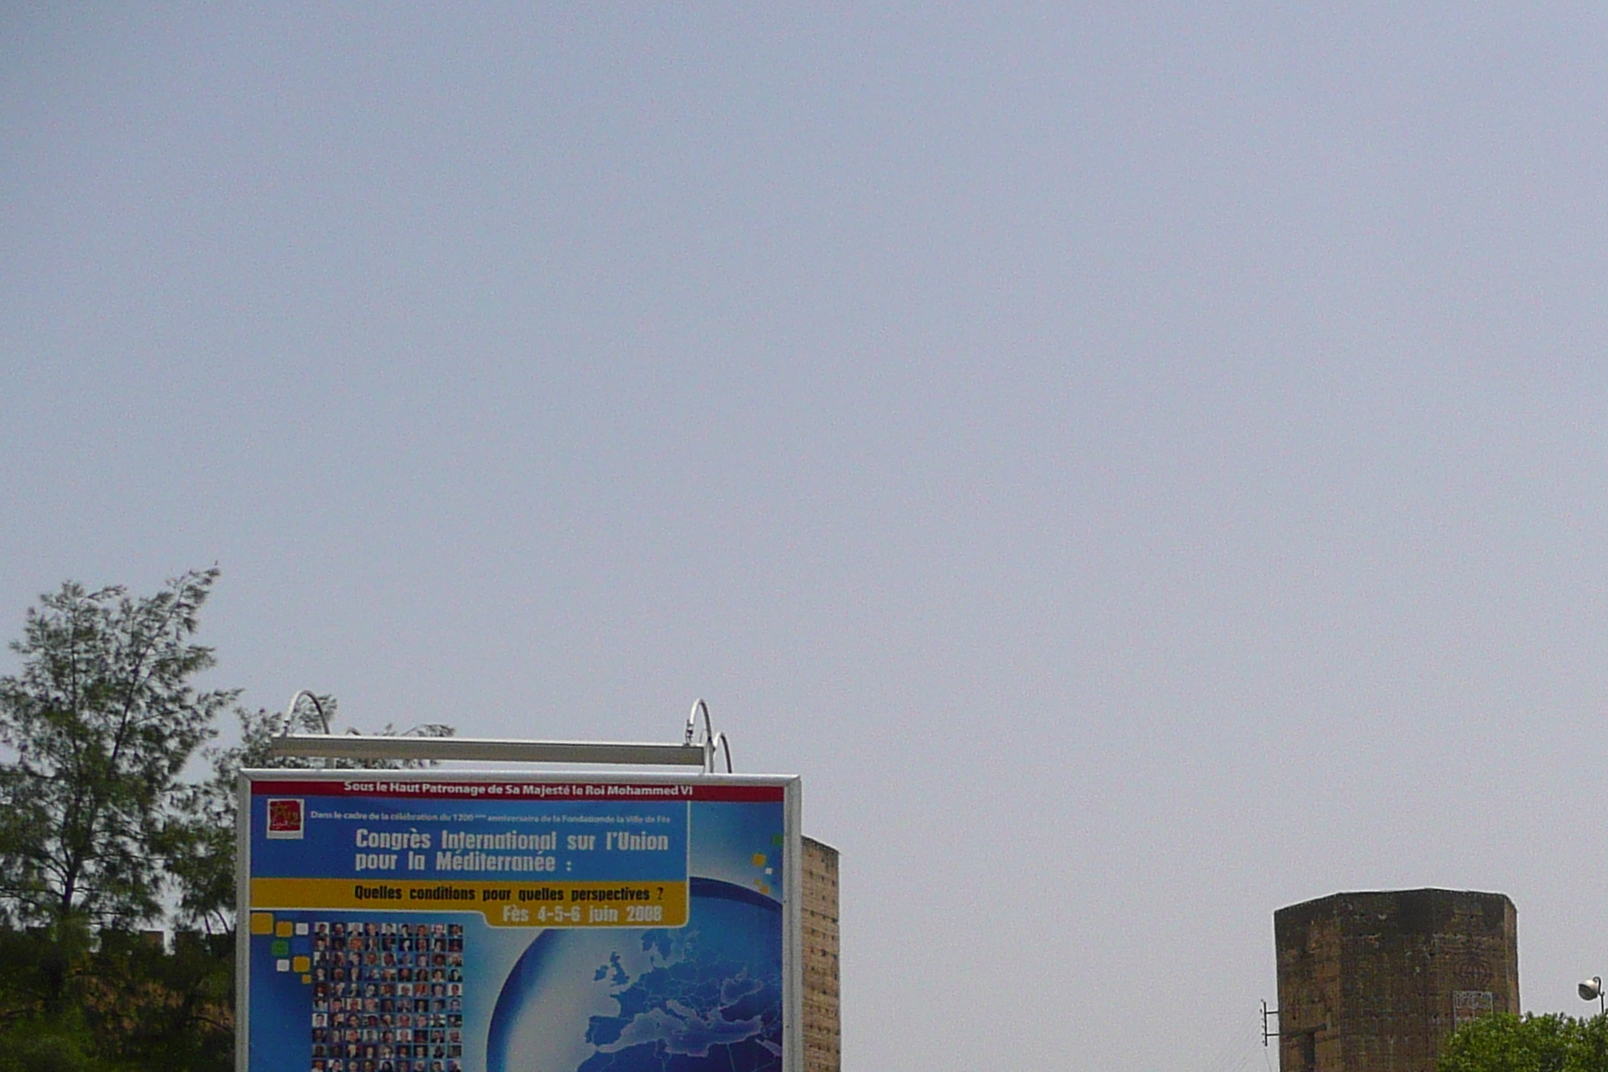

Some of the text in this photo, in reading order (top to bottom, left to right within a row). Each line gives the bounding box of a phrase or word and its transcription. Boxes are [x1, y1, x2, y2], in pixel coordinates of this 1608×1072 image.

[344, 781, 693, 797] Sous le Haut Patronage de Sa Majesté le Roi Mohammed VI
[310, 810, 333, 820] Dans
[344, 811, 368, 820] cadre
[355, 828, 669, 851] Congrès International sur l'Union
[355, 853, 398, 871] pour
[408, 851, 425, 870] la
[436, 849, 556, 872] Méditerranée
[355, 885, 402, 900] Quelles
[409, 886, 476, 900] conditions
[482, 889, 511, 902] pour
[518, 887, 564, 902] quelles
[571, 887, 650, 902] perspectives
[503, 904, 663, 923] Fès 4-5-6 juin 2008
